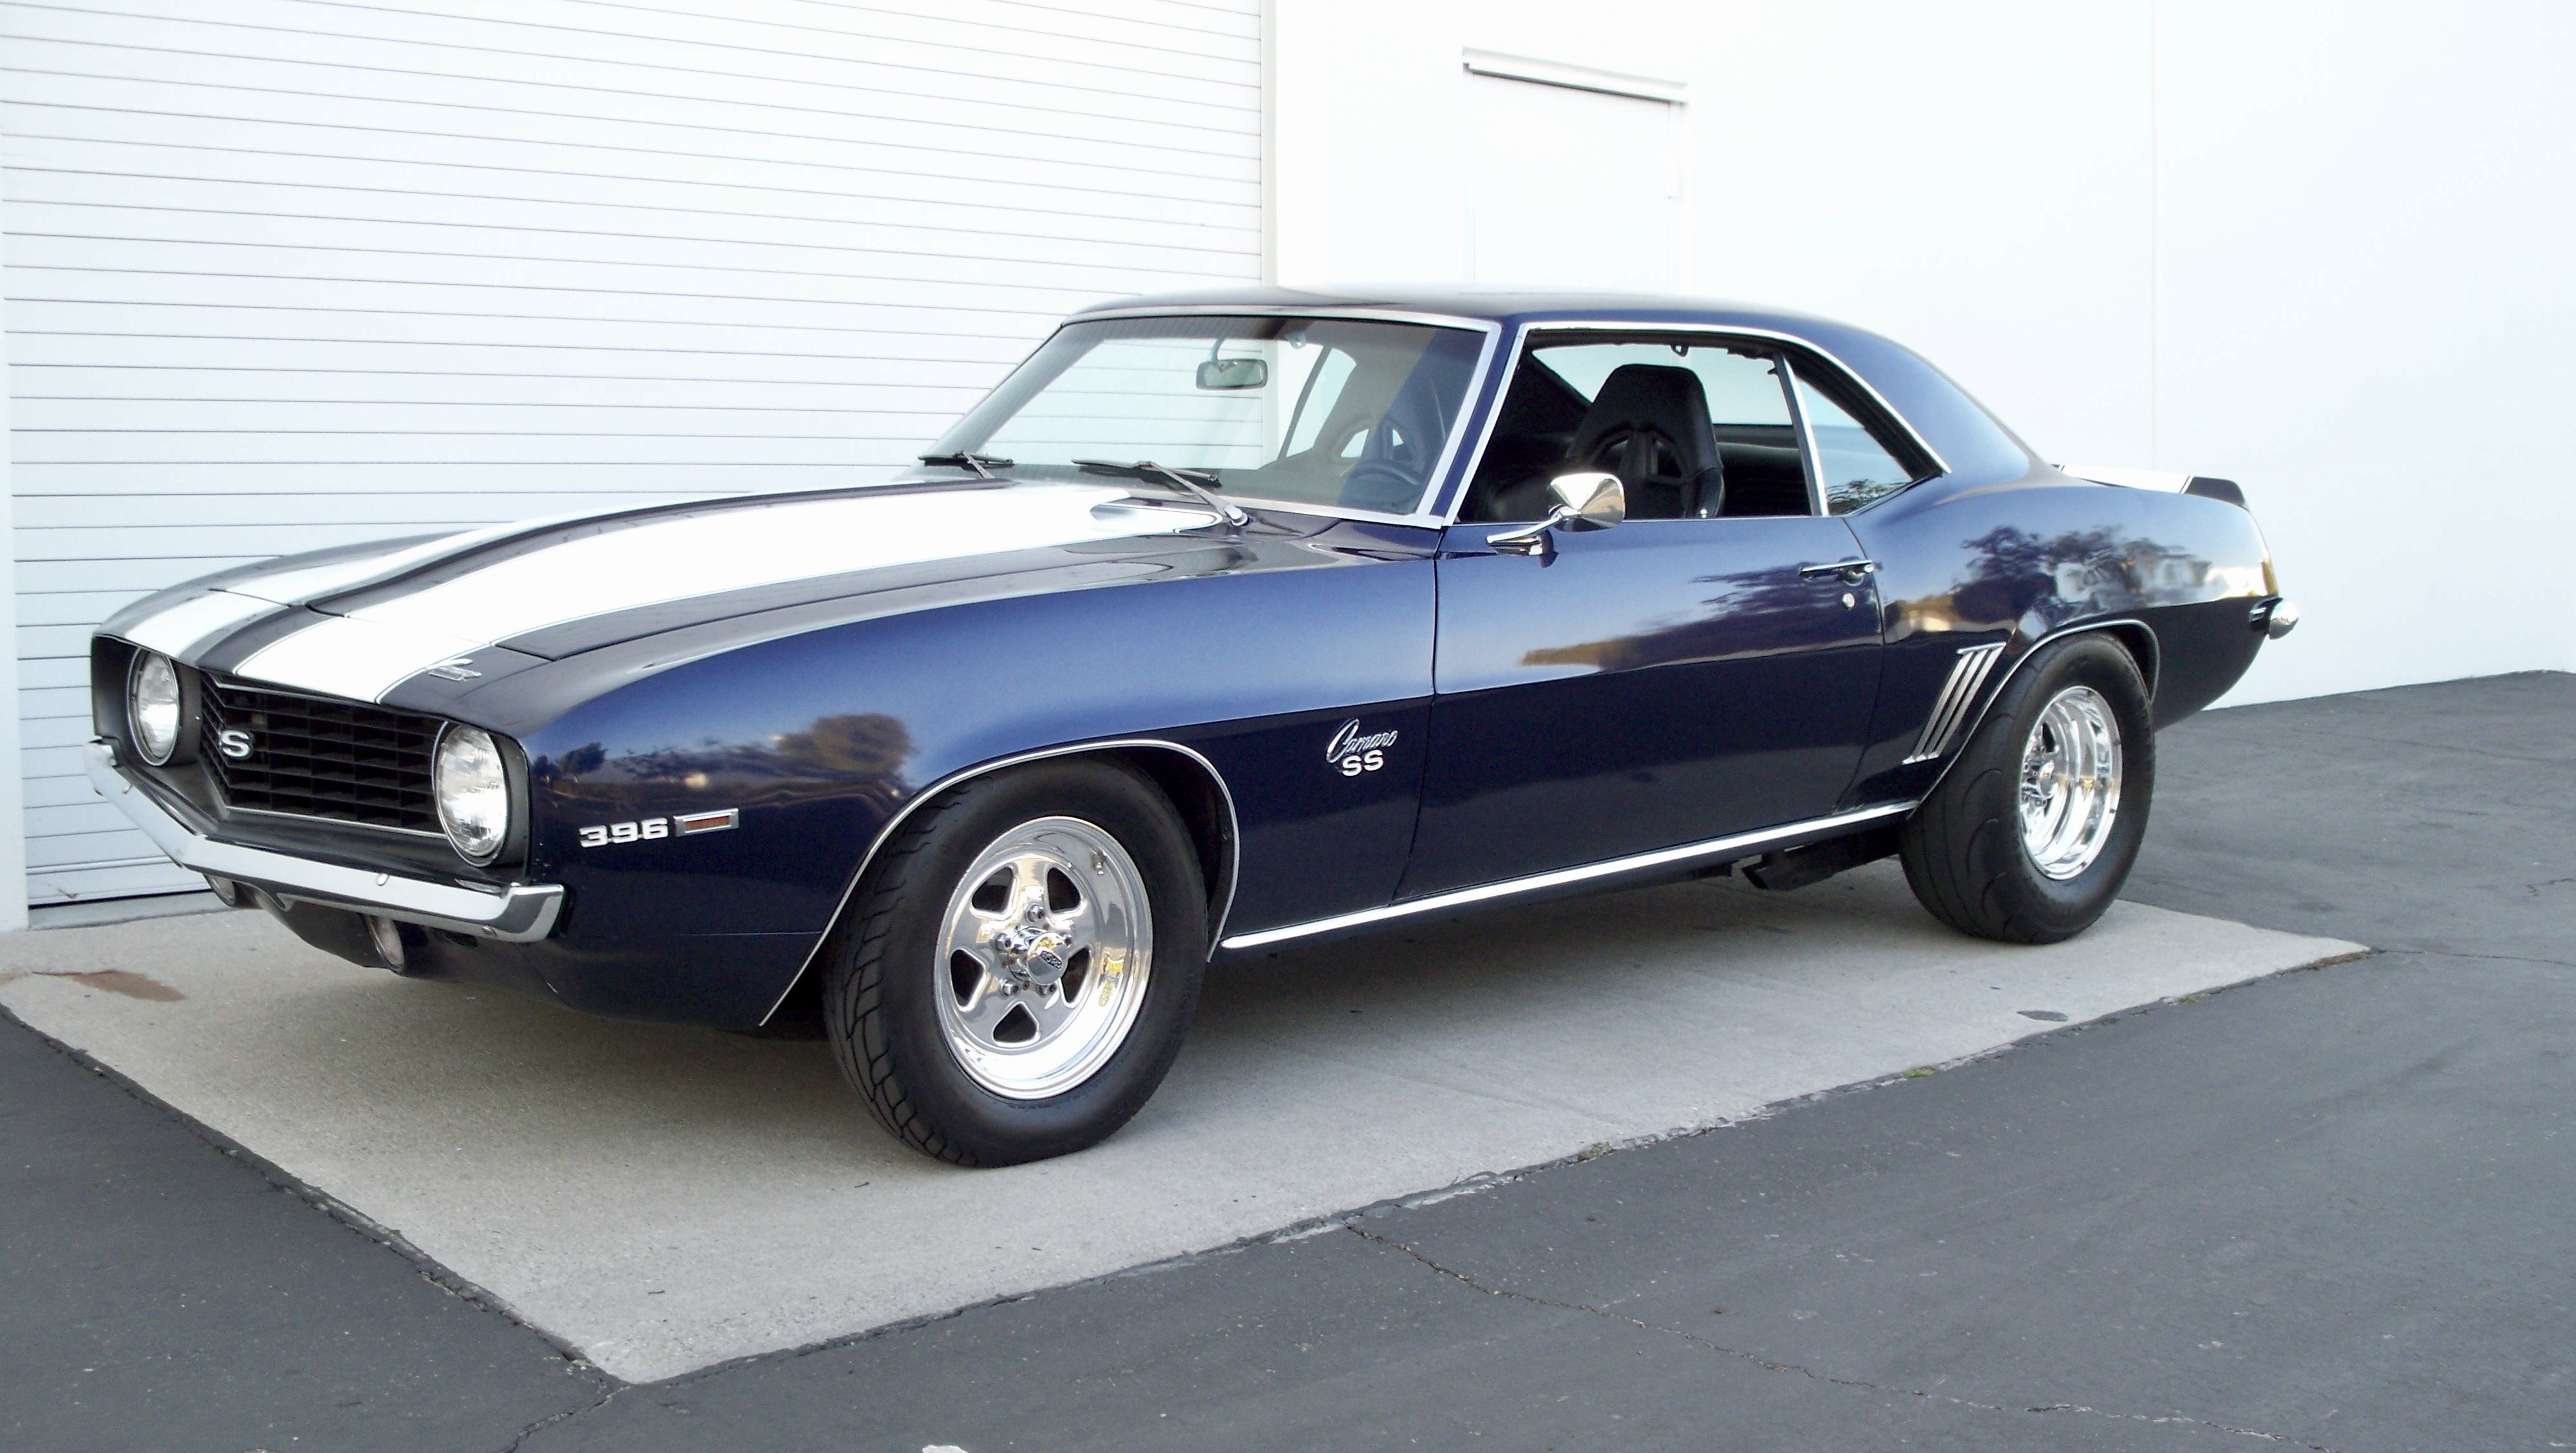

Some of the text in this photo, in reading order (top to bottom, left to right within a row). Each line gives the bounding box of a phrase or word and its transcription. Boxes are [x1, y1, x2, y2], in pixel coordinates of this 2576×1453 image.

[1326, 718, 1399, 763] Camaro
[1341, 749, 1384, 777] SS
[579, 817, 668, 848] 396
